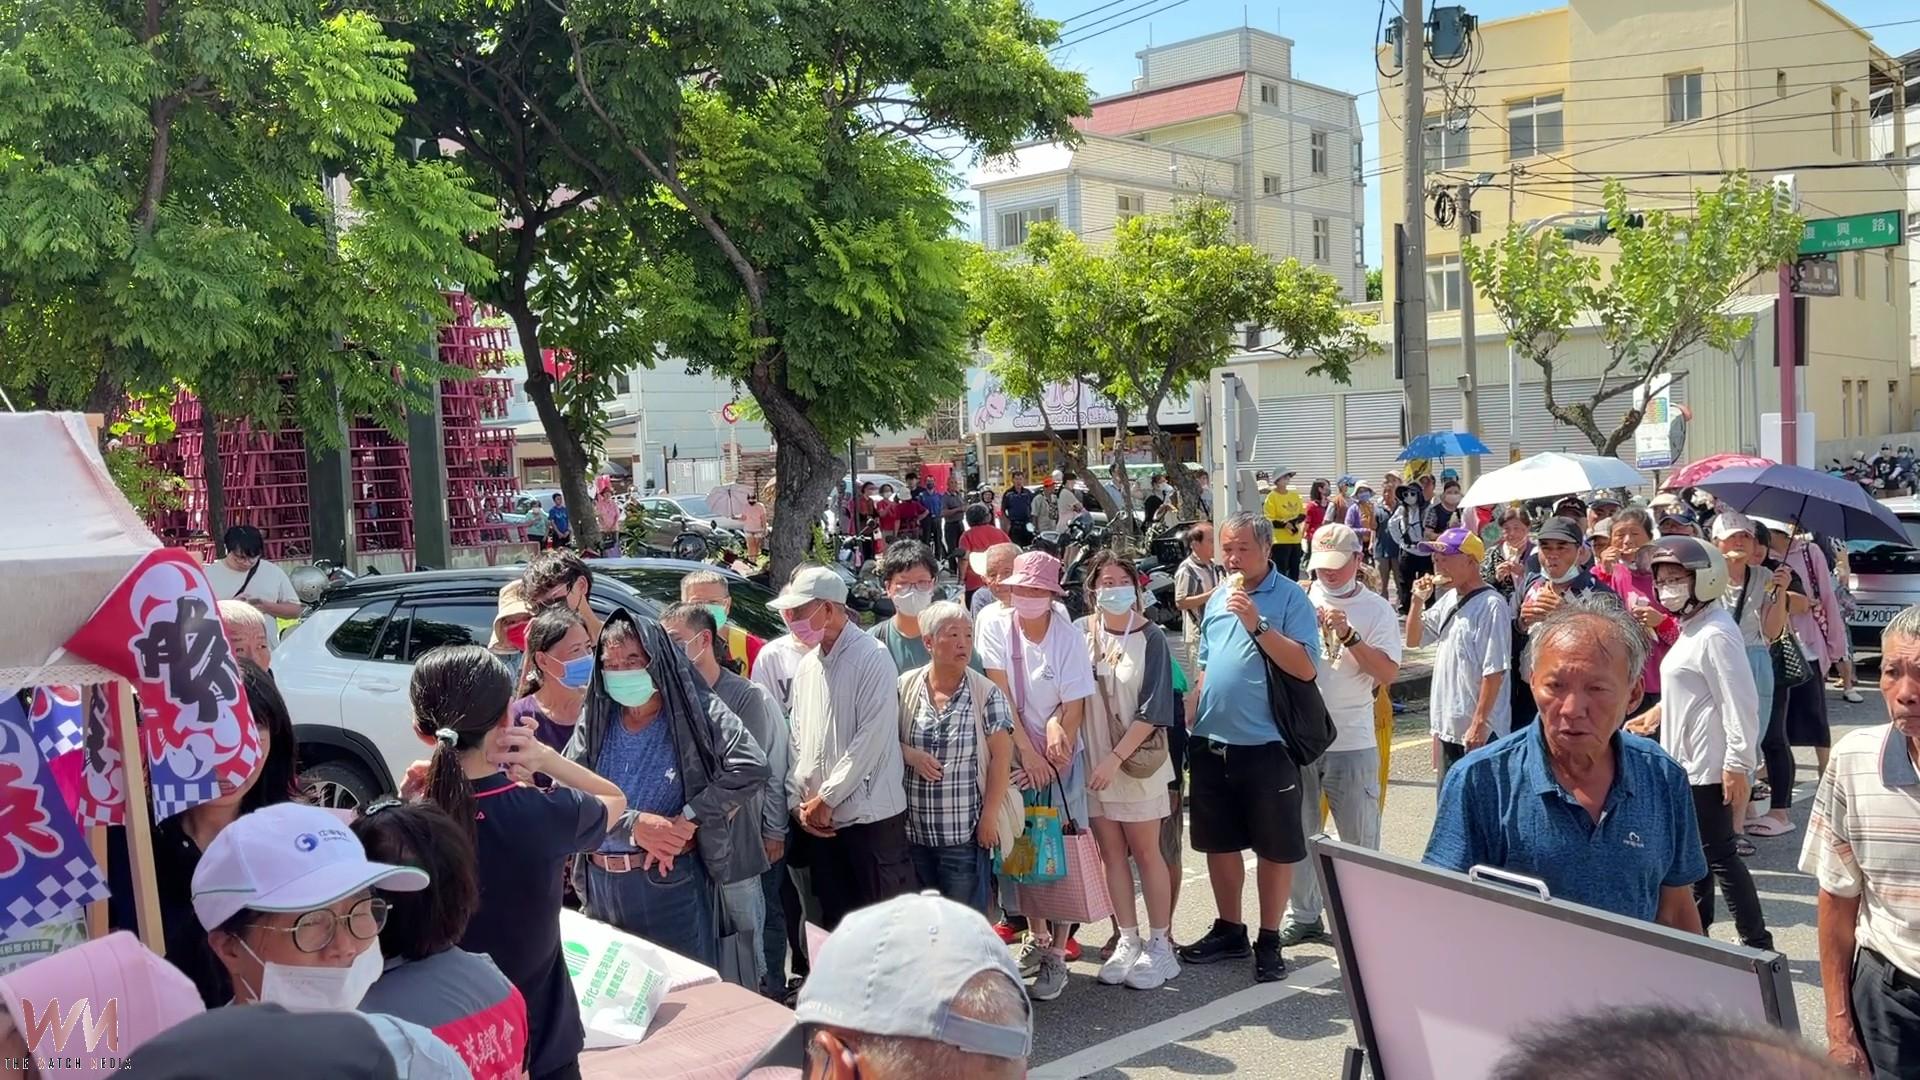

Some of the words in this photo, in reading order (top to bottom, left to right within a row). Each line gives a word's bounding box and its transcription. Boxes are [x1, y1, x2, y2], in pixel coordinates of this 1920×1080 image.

[1803, 217, 1886, 240] 復興路
[1822, 239, 1850, 247] Fuxing
[1852, 237, 1865, 245] Rd.
